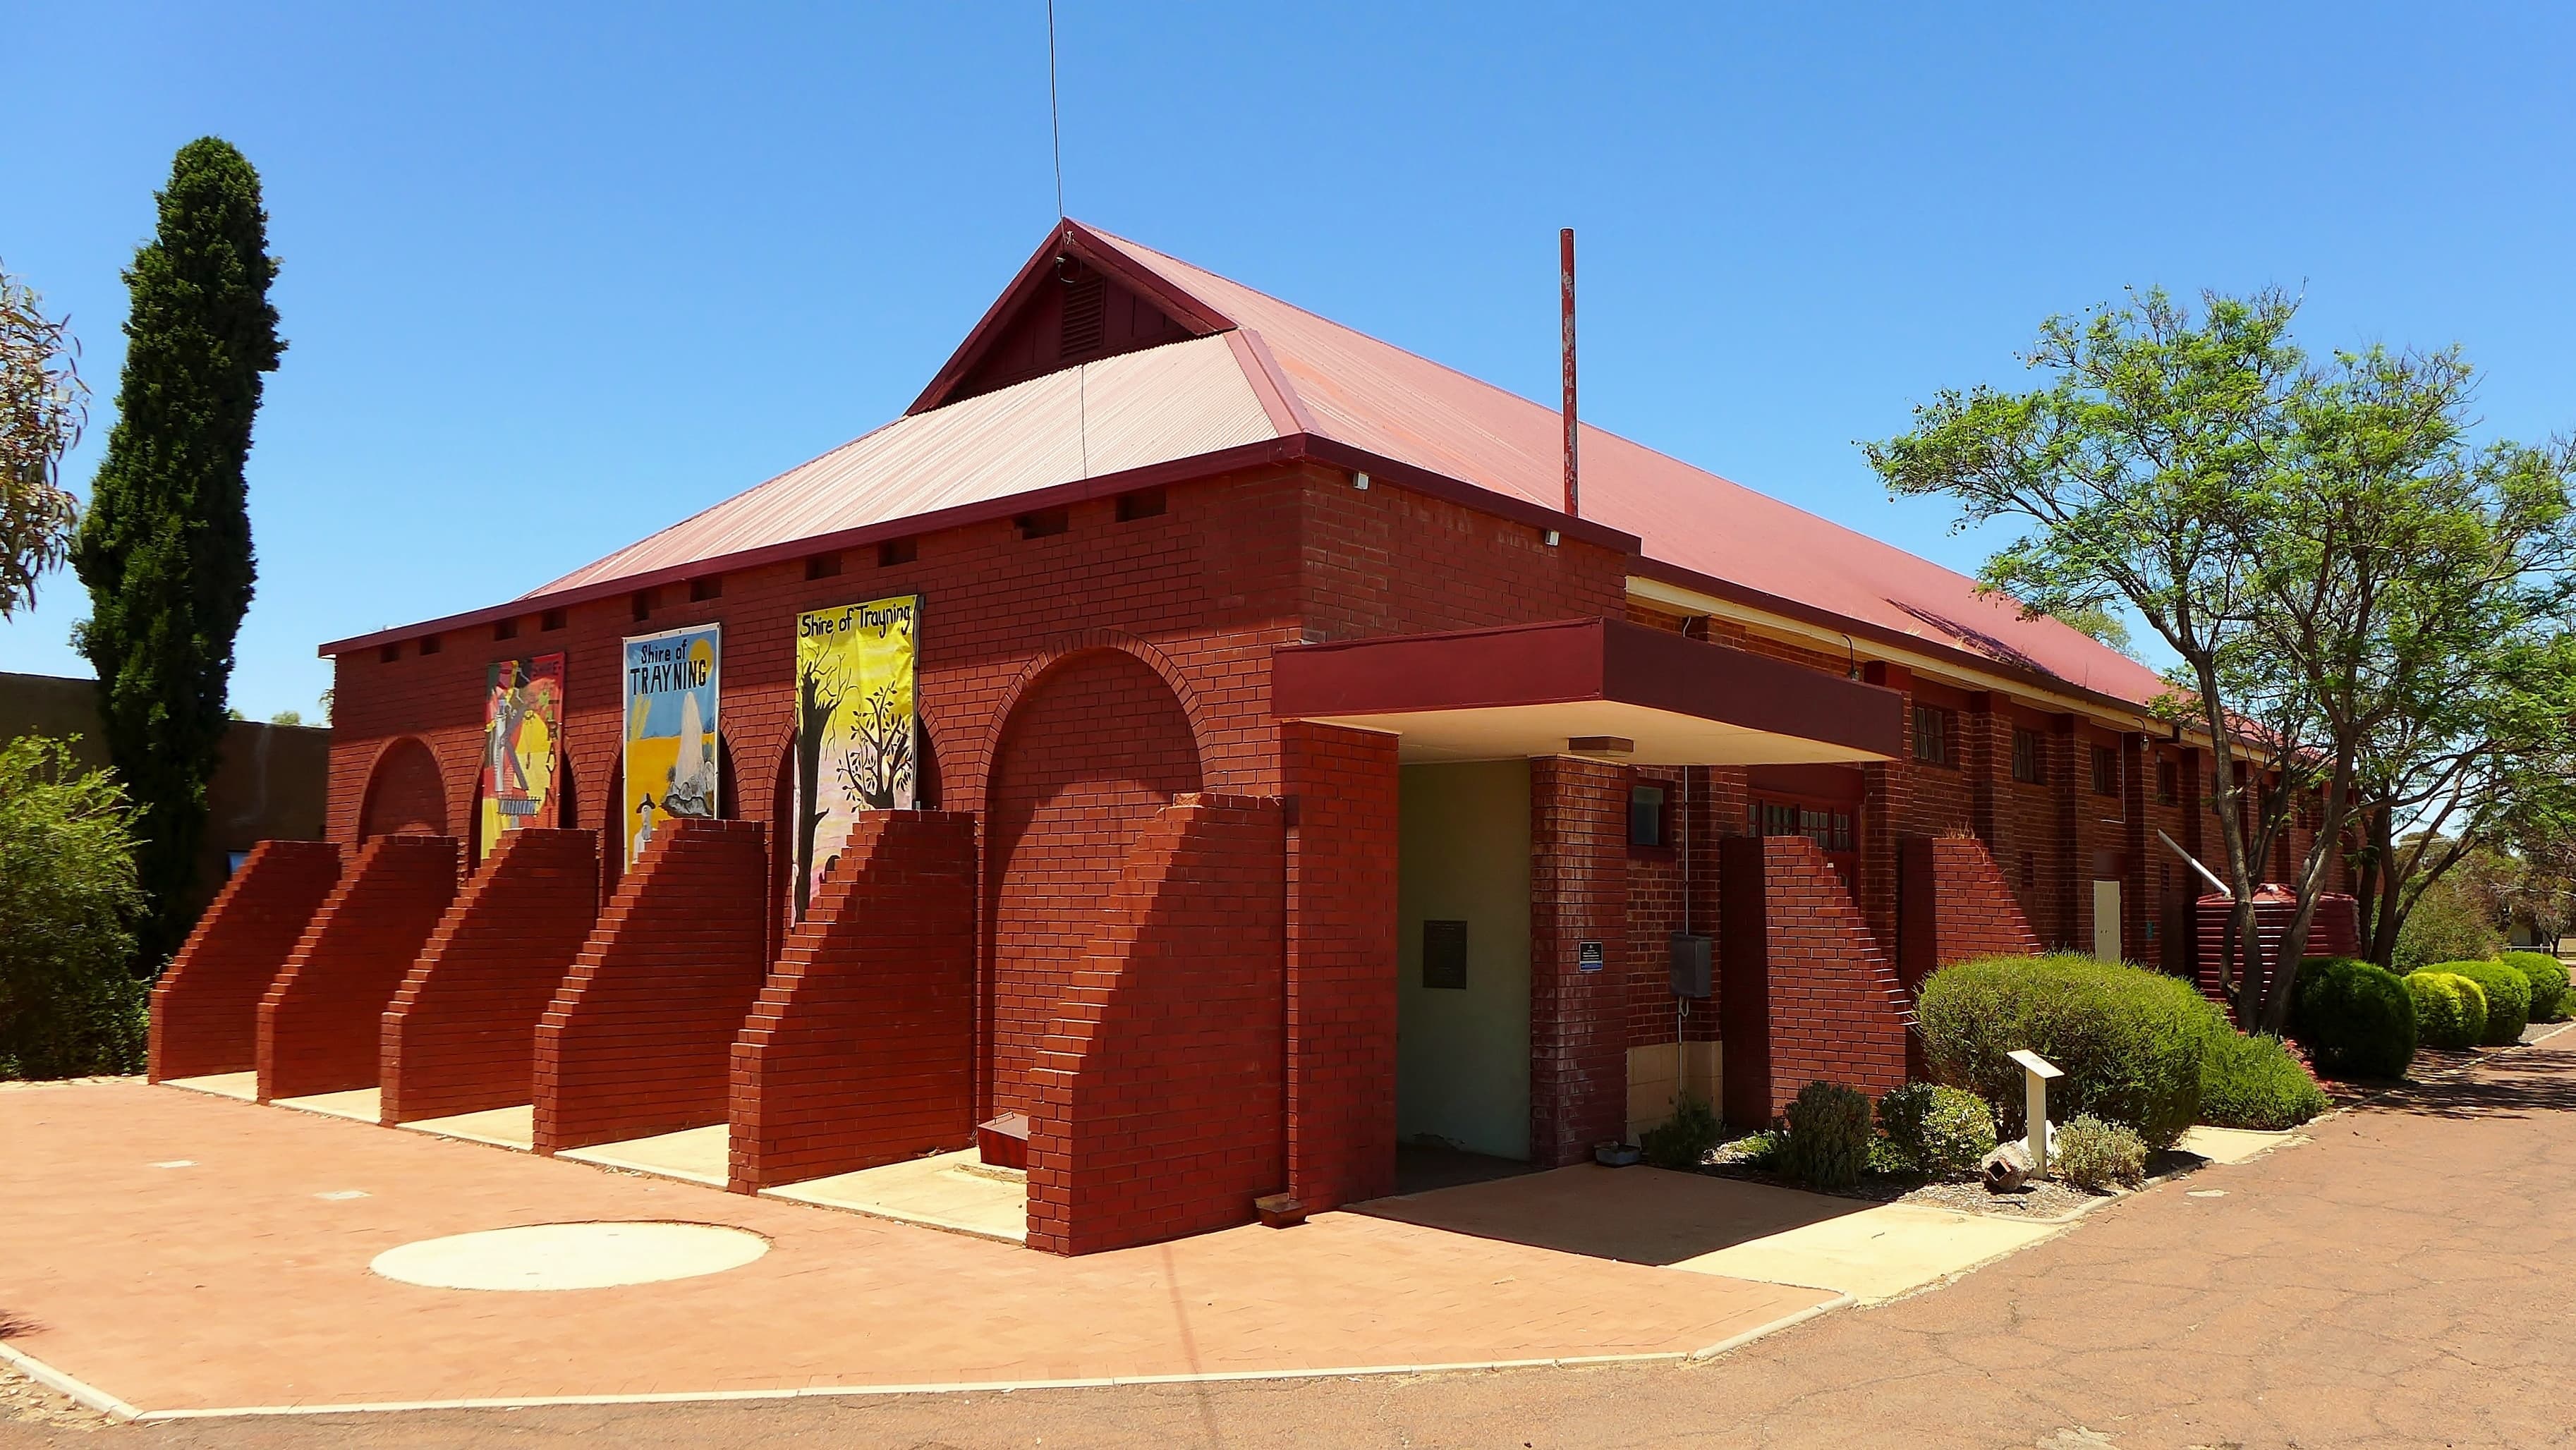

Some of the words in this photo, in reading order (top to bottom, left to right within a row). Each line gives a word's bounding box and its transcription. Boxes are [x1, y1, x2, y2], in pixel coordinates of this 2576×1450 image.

[800, 614, 834, 638] Shire
[839, 607, 854, 631] of
[853, 603, 911, 639] Trayning
[640, 644, 671, 664] Shire
[675, 638, 688, 660] of
[630, 659, 707, 695] TRAYNING
